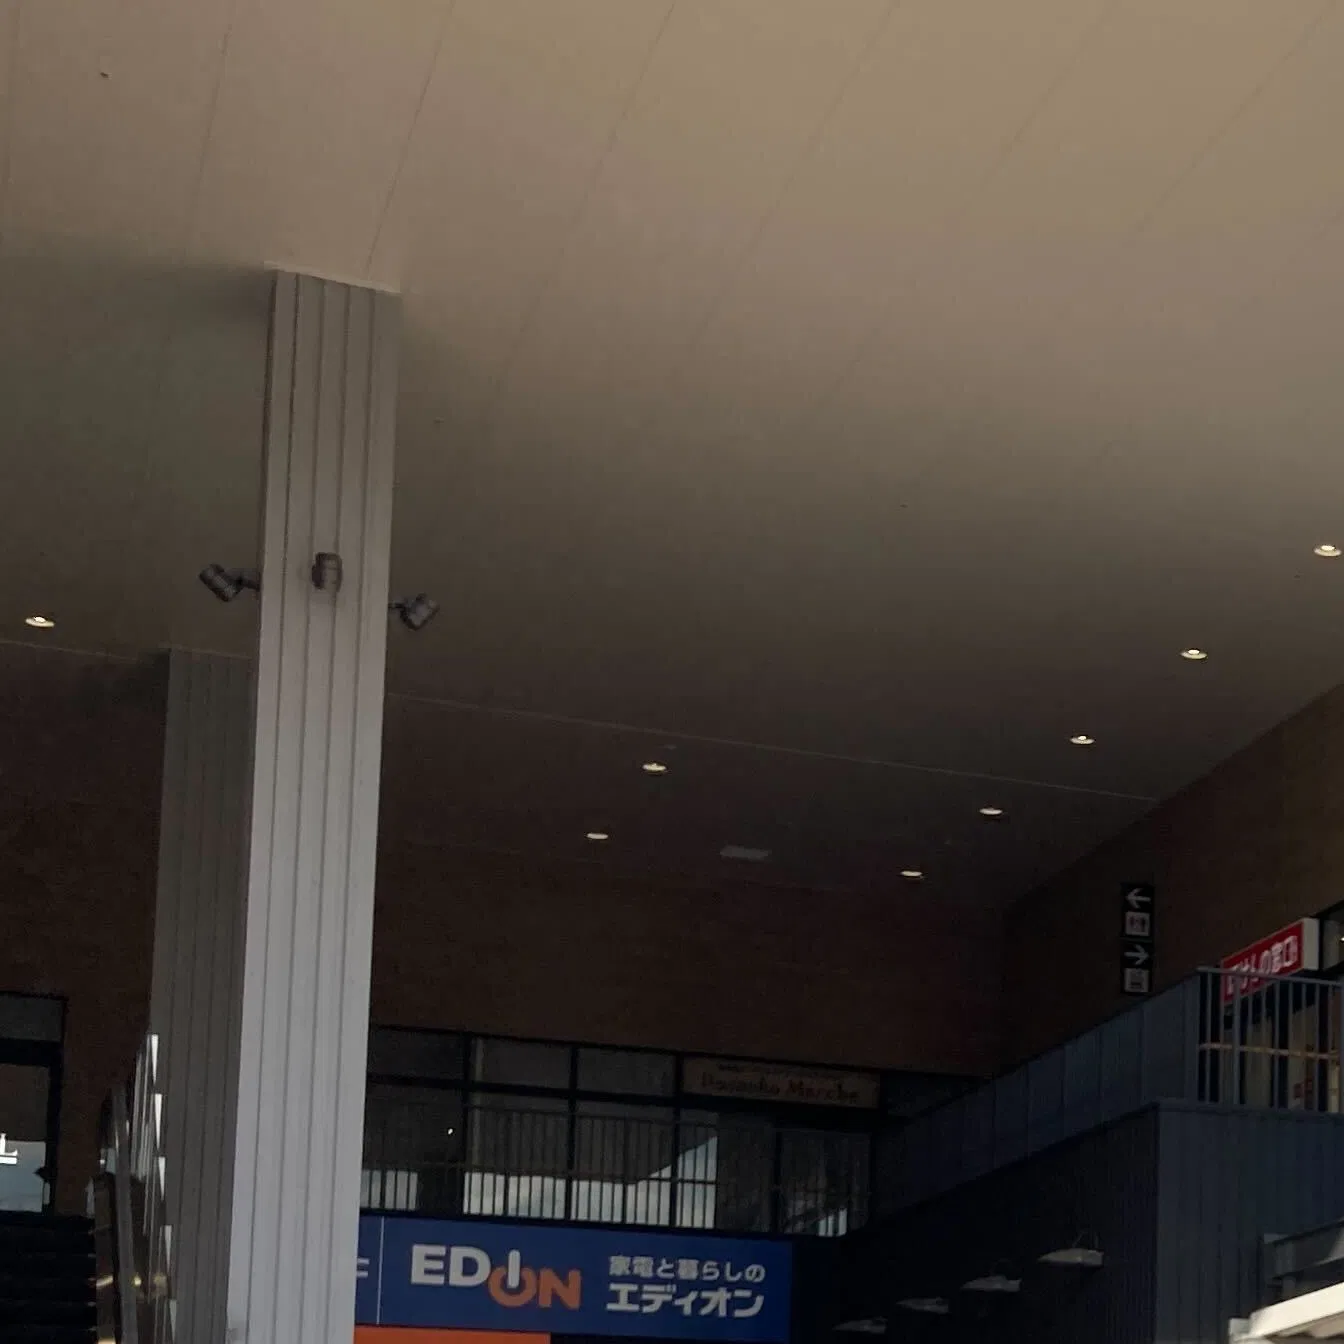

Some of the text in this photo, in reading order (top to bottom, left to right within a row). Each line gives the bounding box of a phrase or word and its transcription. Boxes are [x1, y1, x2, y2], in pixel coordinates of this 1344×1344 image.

[410, 1243, 582, 1311] EDION
[608, 1254, 767, 1284] 家電と暮らしの
[605, 1283, 765, 1318] エディオン
